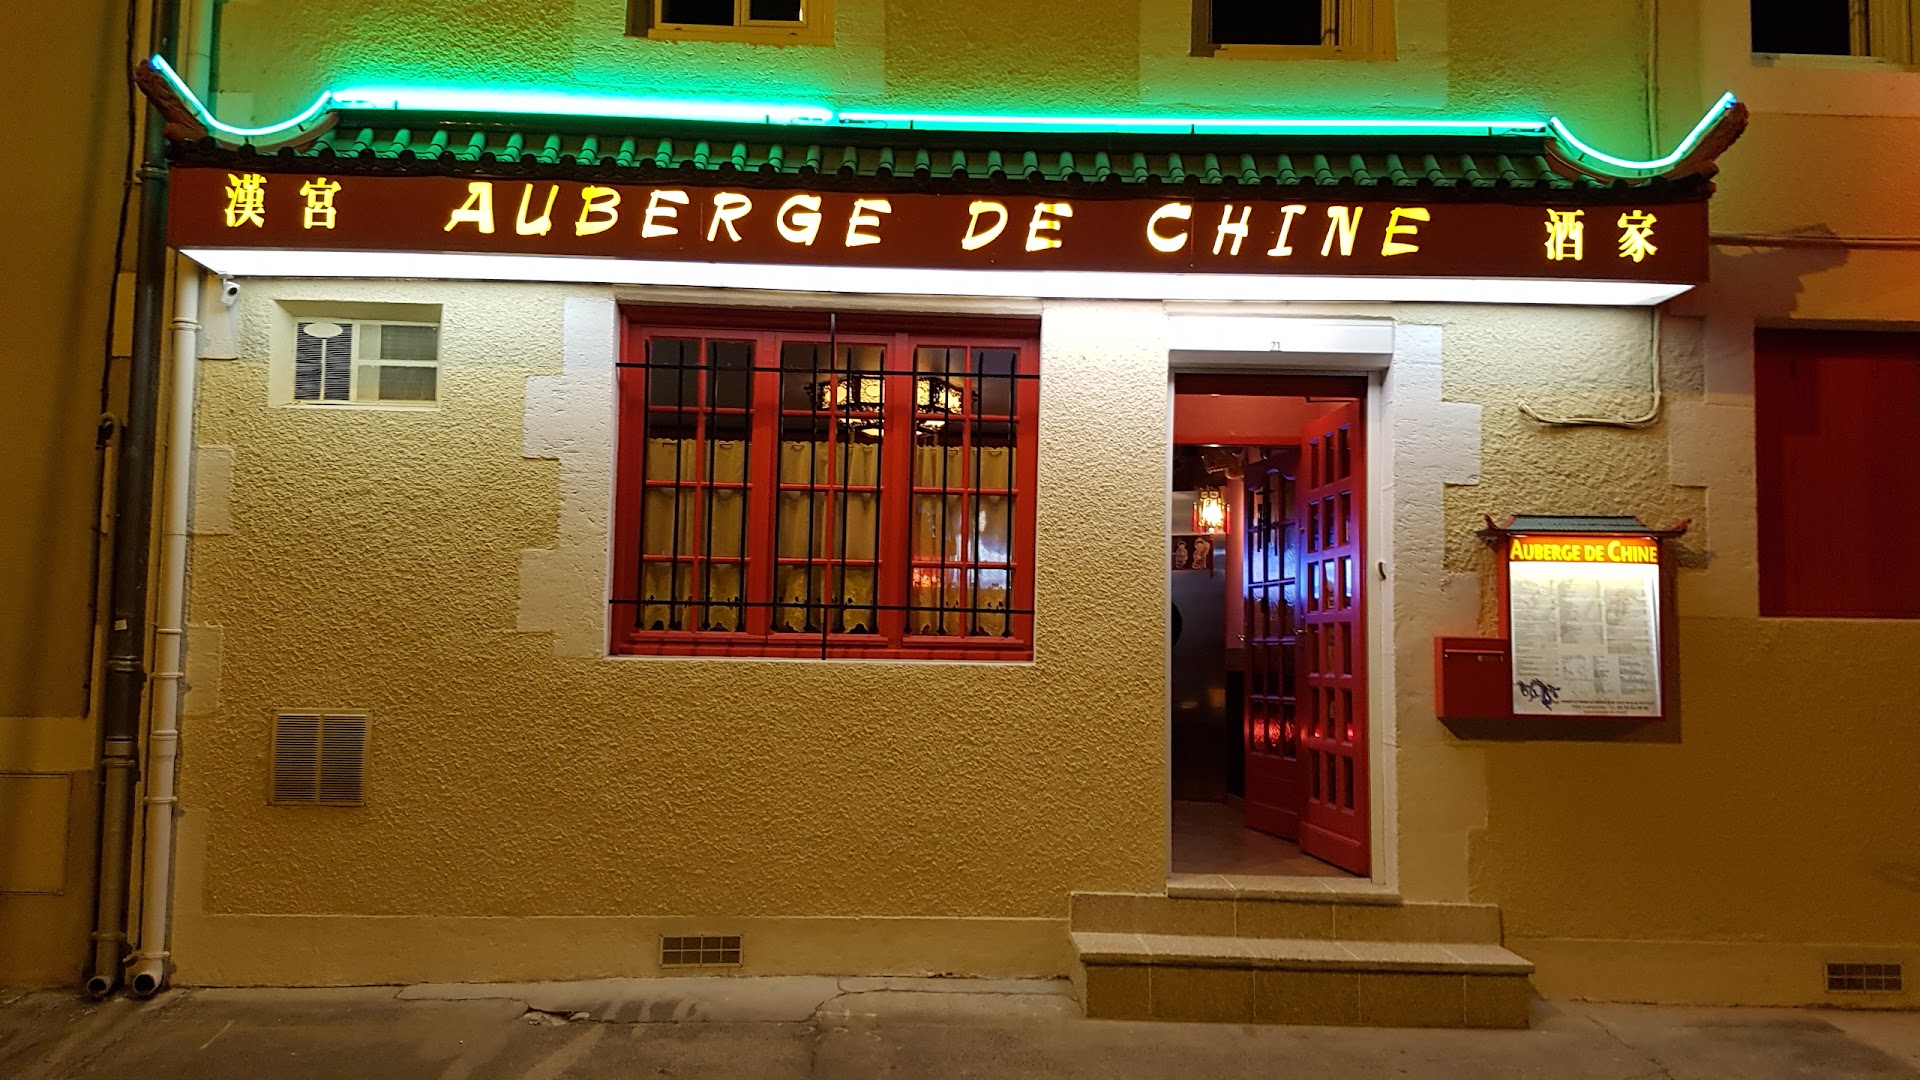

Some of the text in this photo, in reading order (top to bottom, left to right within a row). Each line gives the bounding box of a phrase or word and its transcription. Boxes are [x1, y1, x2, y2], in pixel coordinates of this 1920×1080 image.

[223, 173, 342, 230] 漢宮
[443, 181, 1431, 257] AUBERGE DE CHINE
[1543, 207, 1658, 264] 酒家
[1509, 539, 1581, 561] AUBERGE
[1607, 540, 1658, 563] CHINE
